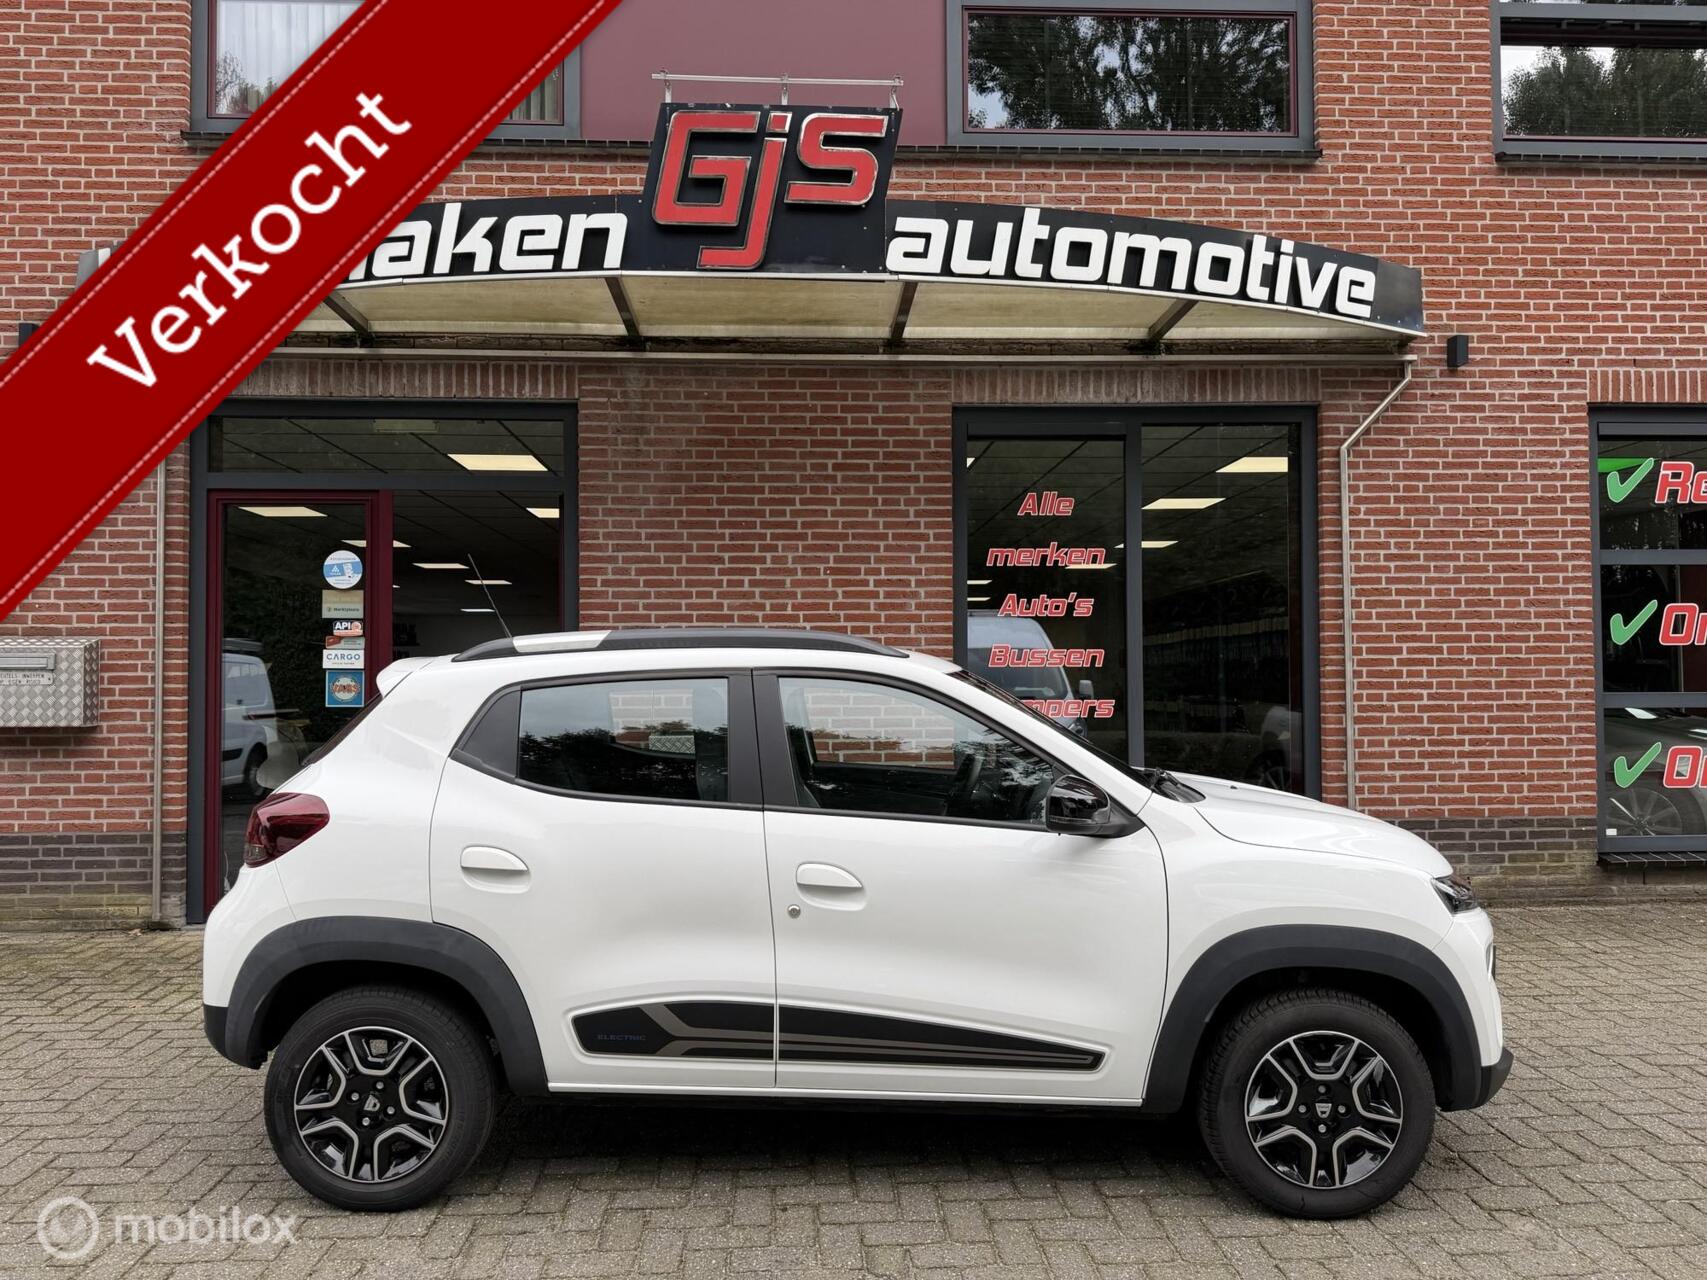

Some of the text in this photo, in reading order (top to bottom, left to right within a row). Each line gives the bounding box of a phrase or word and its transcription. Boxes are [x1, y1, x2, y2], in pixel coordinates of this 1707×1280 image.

[348, 202, 1377, 319] aken automotive
[1017, 491, 1075, 516] Alle
[986, 542, 1106, 567] merken
[998, 592, 1094, 617] Auto's
[335, 621, 351, 630] API
[326, 653, 361, 661] CARGO
[988, 644, 1104, 668] Bussen
[1663, 745, 1707, 789] O
[597, 1033, 647, 1042] ELECTRIC
